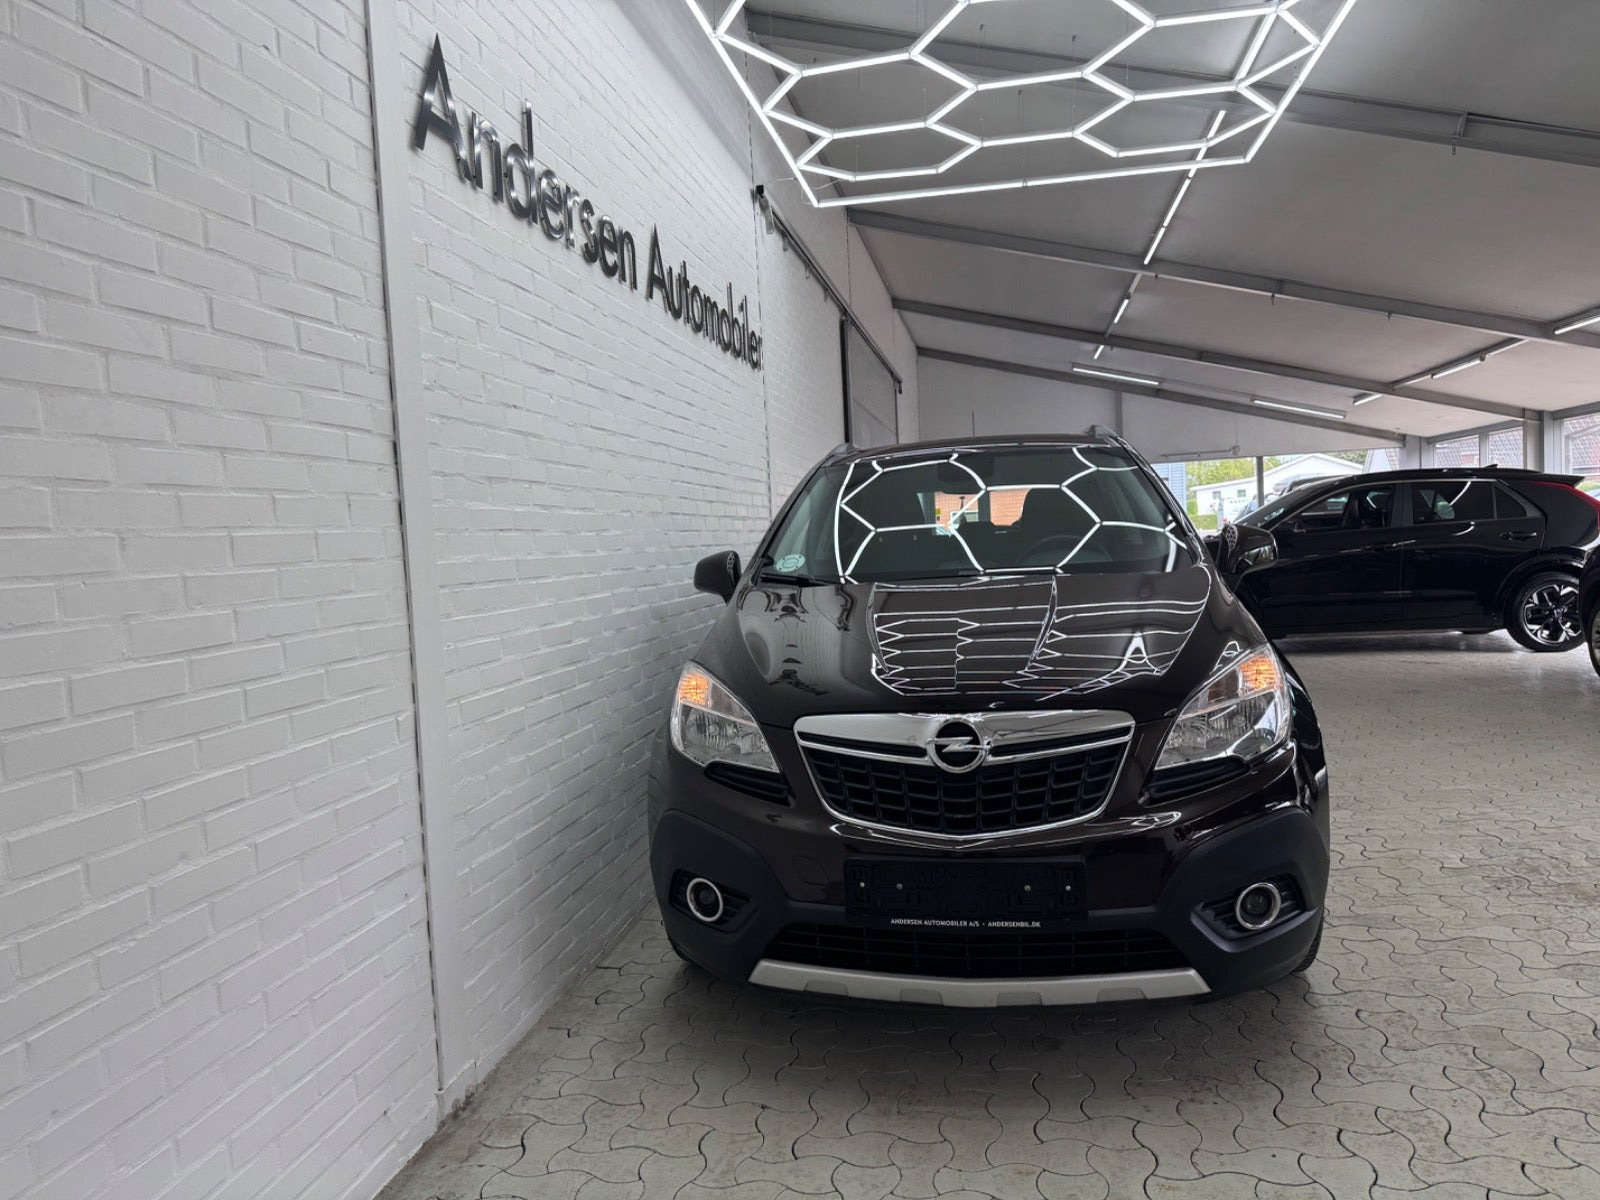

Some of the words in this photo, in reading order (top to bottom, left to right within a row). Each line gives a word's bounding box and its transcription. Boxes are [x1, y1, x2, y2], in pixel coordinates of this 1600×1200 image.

[412, 32, 638, 291] Andersen
[646, 223, 763, 370] Automobiler
[890, 918, 922, 926] ANDERSEN
[923, 919, 967, 927] AUTOMOBILER
[968, 920, 980, 928] A/S
[987, 920, 1041, 928] ANDERSENBIL.DK
